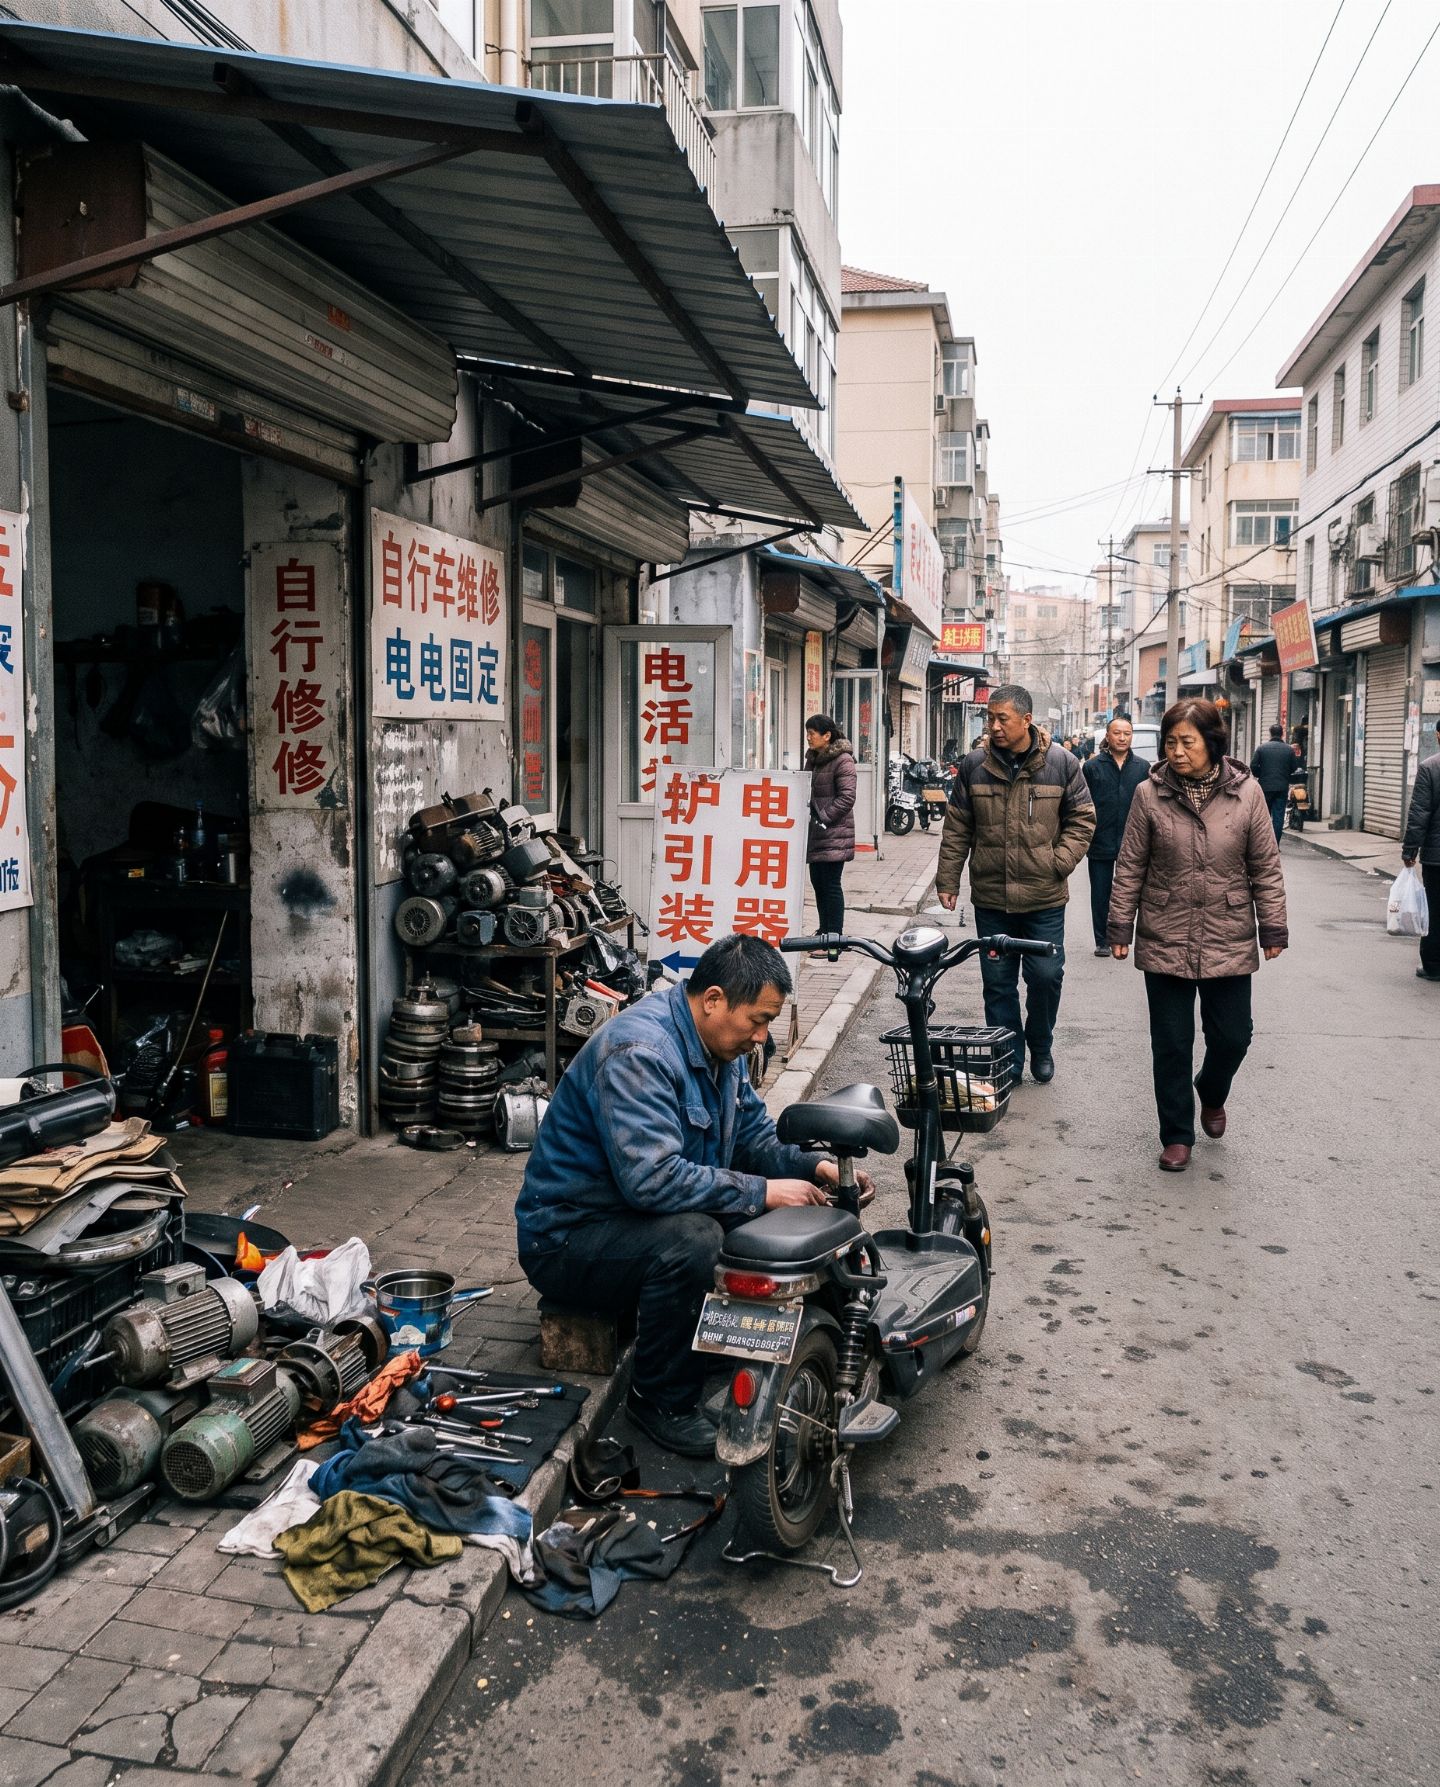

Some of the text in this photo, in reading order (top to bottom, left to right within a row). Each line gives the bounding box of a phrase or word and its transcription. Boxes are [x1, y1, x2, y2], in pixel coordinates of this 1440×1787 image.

[382, 530, 500, 626] 自行车维修
[270, 558, 326, 795] 自行修修
[386, 627, 499, 705] 电电固定
